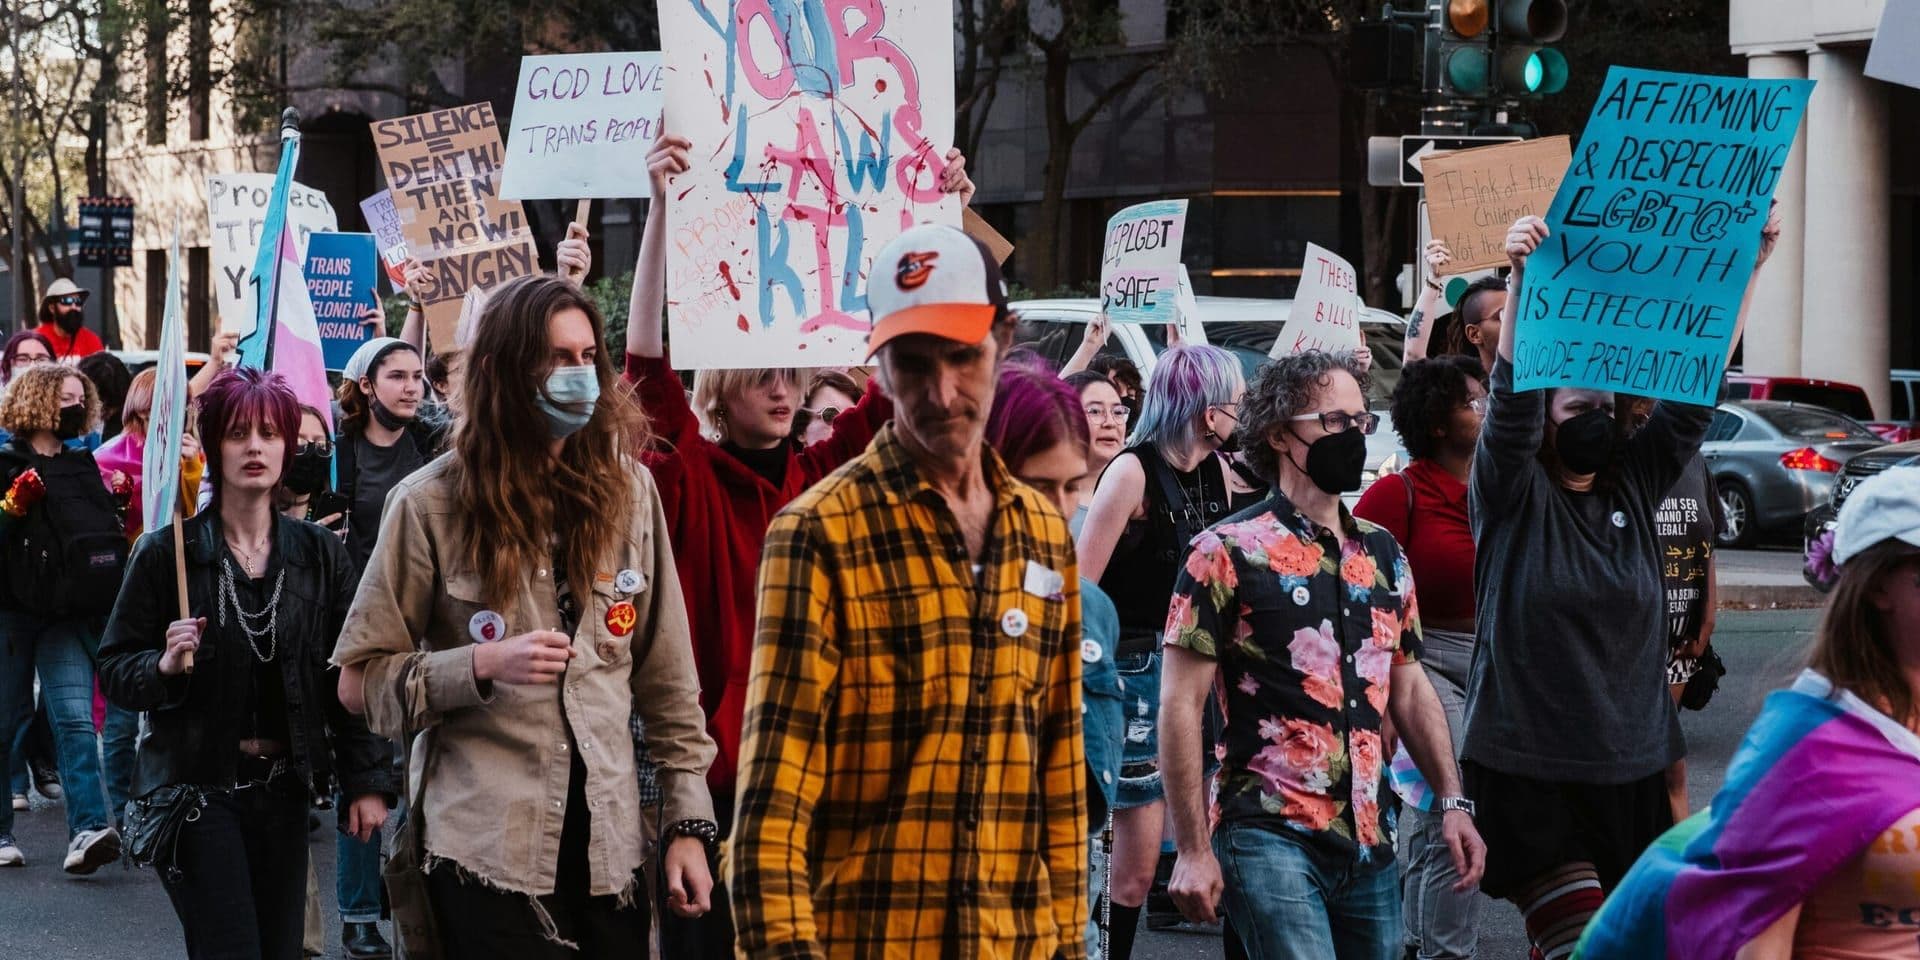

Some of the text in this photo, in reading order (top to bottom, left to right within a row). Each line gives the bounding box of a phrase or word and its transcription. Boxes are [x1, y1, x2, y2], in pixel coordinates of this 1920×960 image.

[692, 0, 922, 112] YOUR
[528, 66, 590, 100] GOD
[1597, 77, 1792, 133] AFFIRMING
[377, 103, 496, 149] SILENCE
[521, 120, 597, 156] TRANS
[388, 141, 502, 189] DEATH!
[724, 103, 948, 204] LAWS
[1574, 136, 1786, 198] & RESPECTING
[406, 174, 495, 210] THEN
[1433, 168, 1501, 210] Think
[1527, 165, 1558, 193] the
[429, 211, 520, 250] NOW!
[438, 203, 485, 225] AND
[1562, 186, 1757, 243] LGBTQ+
[1443, 232, 1475, 262] Not
[1552, 231, 1739, 283] YOUTH
[310, 257, 351, 276] TRANS
[757, 200, 914, 334] KIL
[1317, 257, 1354, 293] THESE
[307, 279, 353, 298] PEOPLE
[1115, 276, 1160, 309] SAFE
[312, 301, 369, 318] ELONG IN
[1315, 301, 1352, 330] BILLS
[1558, 287, 1728, 340] EFFECTIVE
[318, 322, 365, 340] ISIANA
[1515, 337, 1720, 399] SUICIDE PREVENTION
[1655, 510, 1698, 523] MANO ES
[1680, 498, 1699, 511] SER
